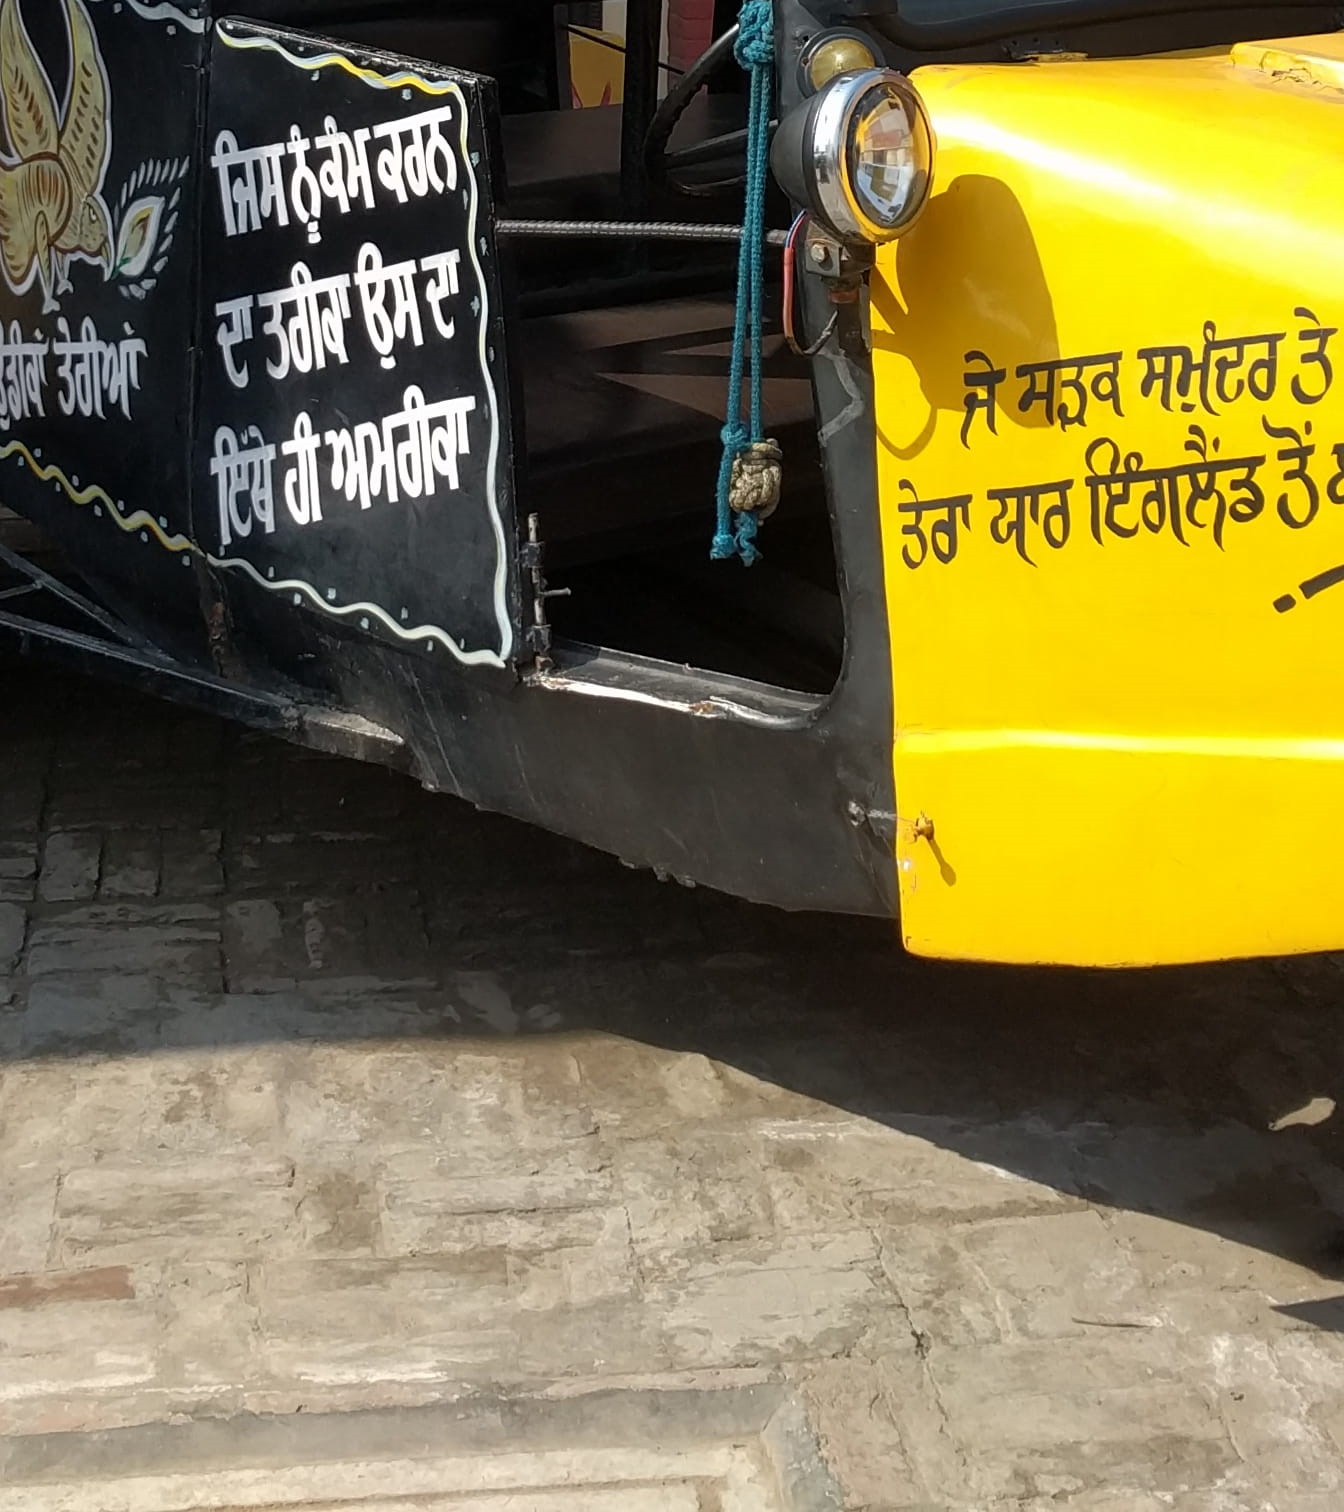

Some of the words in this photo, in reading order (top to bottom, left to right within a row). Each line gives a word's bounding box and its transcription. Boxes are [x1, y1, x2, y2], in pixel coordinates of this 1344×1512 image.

[211, 129, 289, 237] ਜਿਸ
[315, 115, 375, 213] ਕੰਮ
[372, 105, 457, 204] ਕਰਨ
[53, 316, 148, 420] ਤੇਰੀਆਂ
[216, 295, 253, 388] ਦਾ
[258, 261, 351, 380] ਤਰੀਕਾ
[421, 249, 459, 339] ਦਾ
[960, 350, 1006, 449] ਜੇ
[1016, 351, 1125, 432] ਸੜਕ
[1137, 321, 1286, 416] ਸਮੁੰਦਰ
[1291, 306, 1338, 404] ਤੇ
[281, 411, 323, 525] ਹੀ
[324, 384, 476, 510] ਅਮਰੀਕਾ
[898, 479, 973, 570] ਤੇਰਾ
[987, 478, 1074, 568] ਯਾਰ
[1085, 424, 1266, 552] ਇੰਗਲੈਂਡ
[1262, 415, 1319, 529] ਤੋਂ
